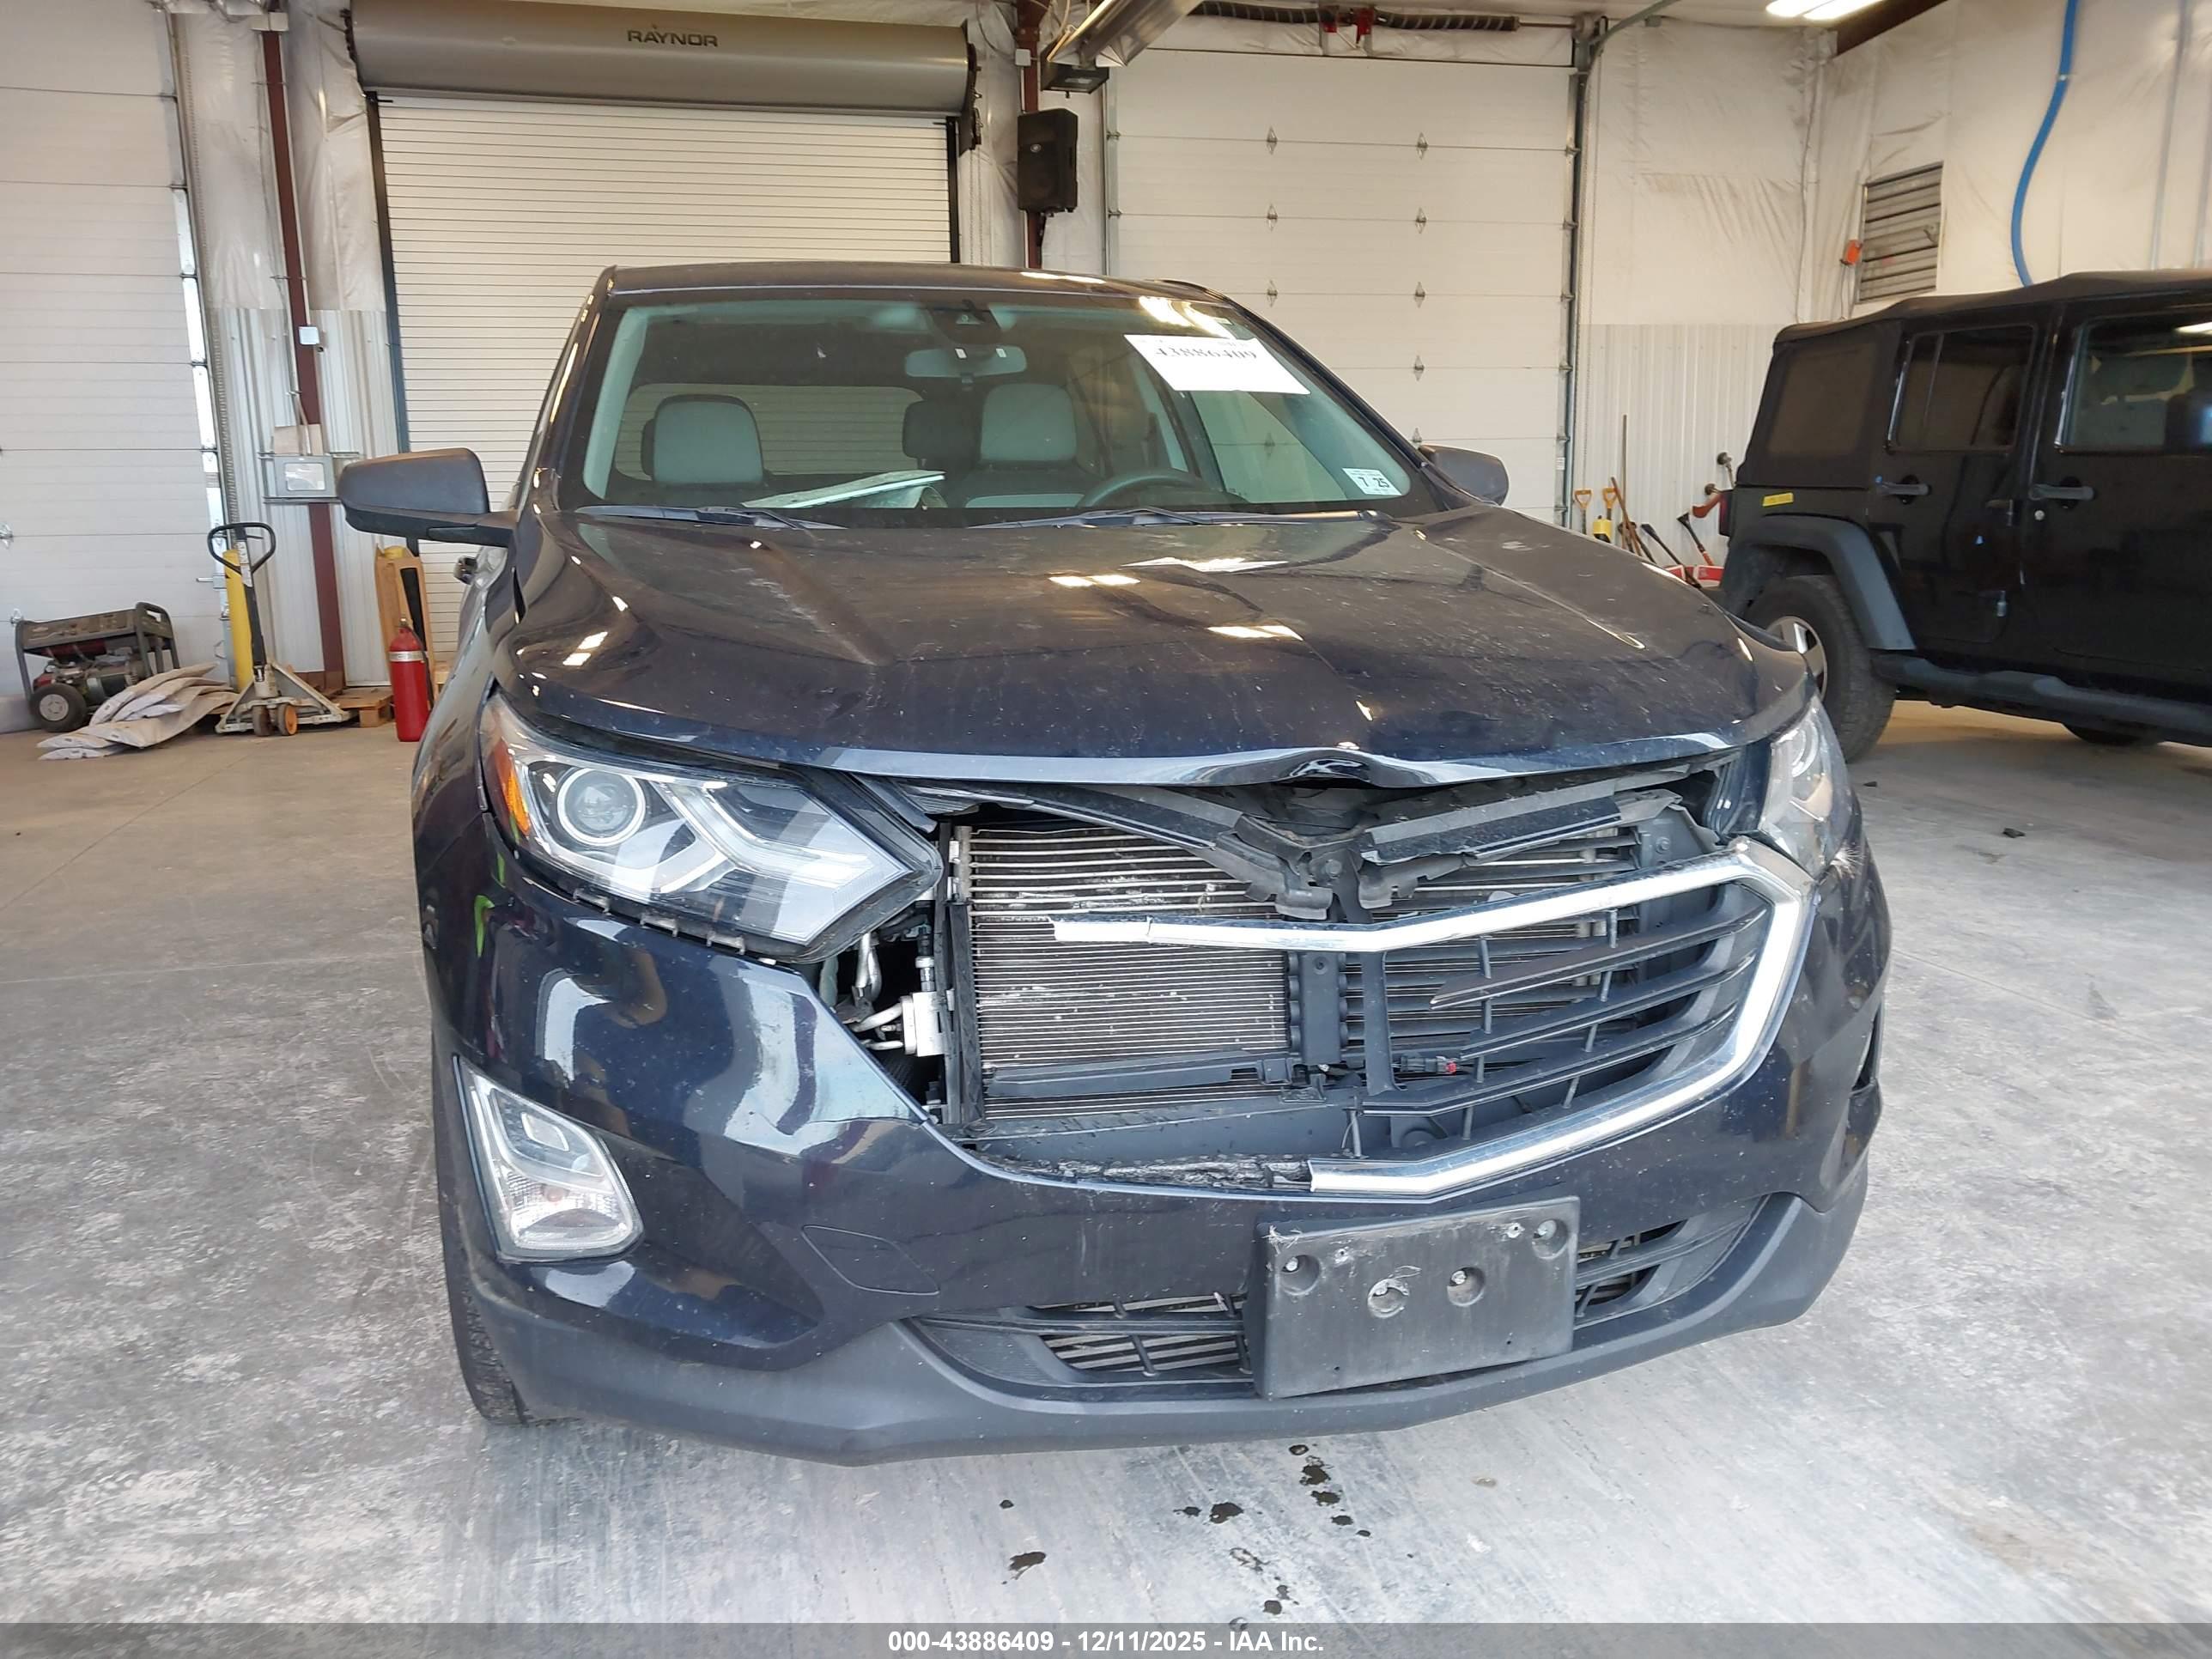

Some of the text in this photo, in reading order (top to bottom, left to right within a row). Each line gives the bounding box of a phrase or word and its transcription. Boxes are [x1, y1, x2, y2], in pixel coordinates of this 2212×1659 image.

[627, 28, 719, 47] RAYNOR
[1358, 476, 1390, 489] 7 25
